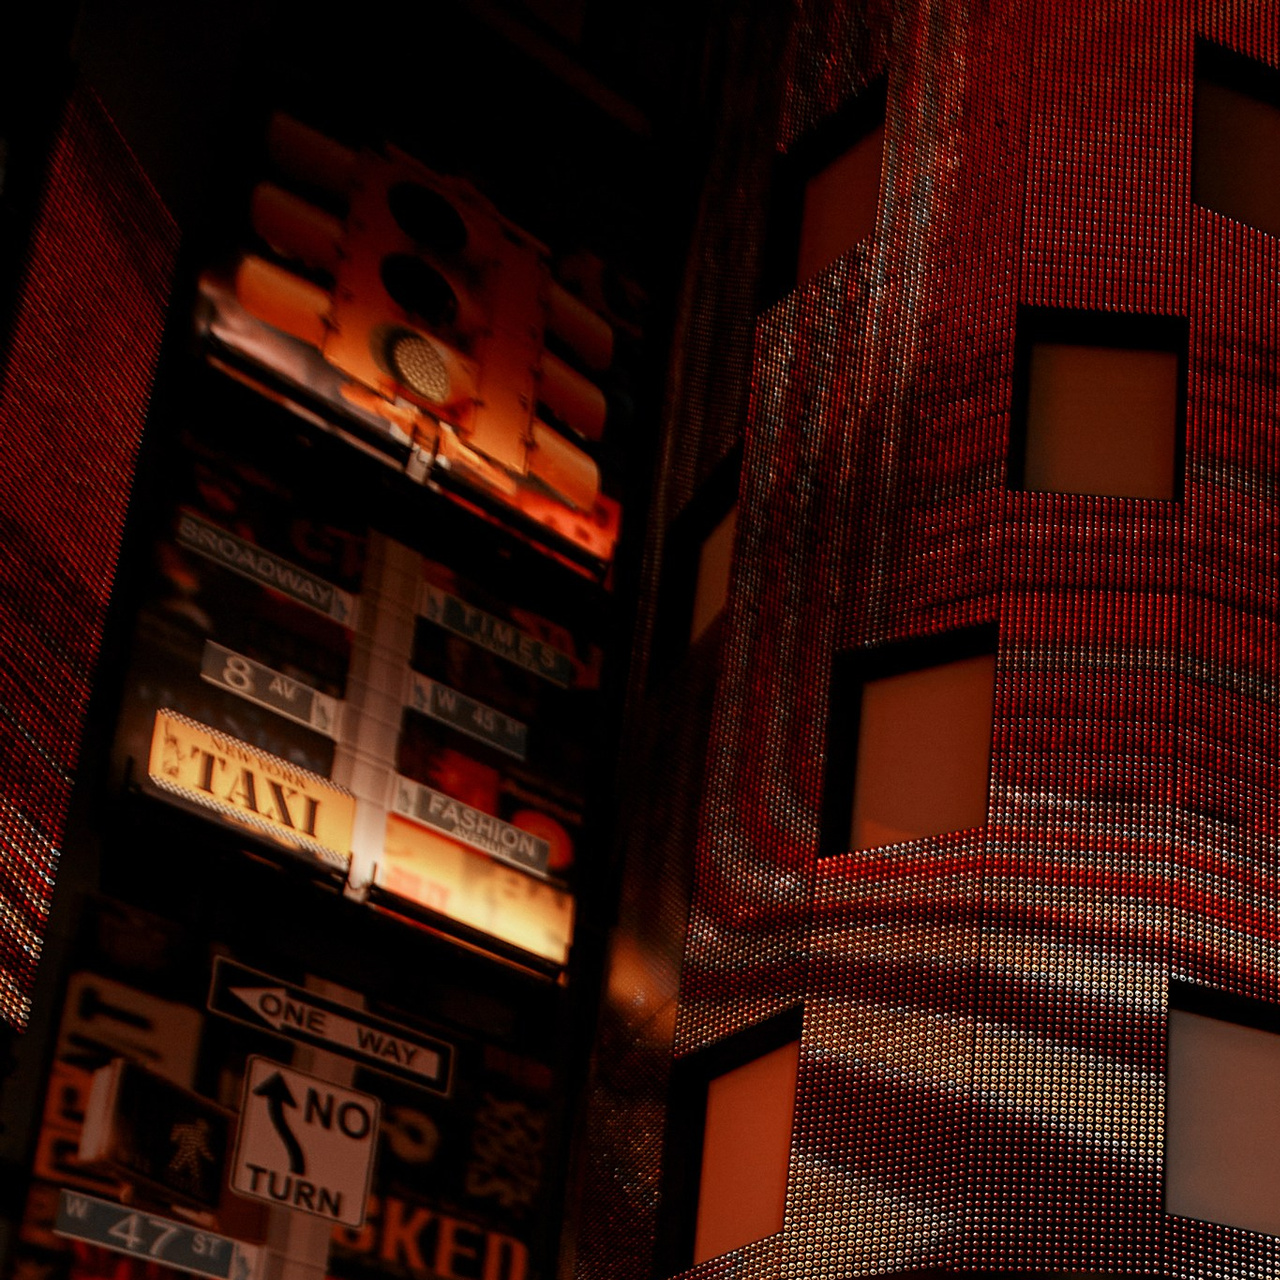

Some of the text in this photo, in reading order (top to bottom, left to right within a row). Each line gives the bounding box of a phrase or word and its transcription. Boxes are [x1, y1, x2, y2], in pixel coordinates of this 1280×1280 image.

[181, 517, 333, 608] BROADWAY
[222, 655, 297, 703] 8 AV
[209, 735, 245, 762] NEW
[189, 743, 323, 838] TAXI
[429, 793, 537, 858] FASHION
[259, 992, 417, 1066] ONE WAY
[304, 1087, 371, 1140] NO
[245, 1162, 342, 1219] TURN
[65, 1199, 227, 1257] W 47 ST
